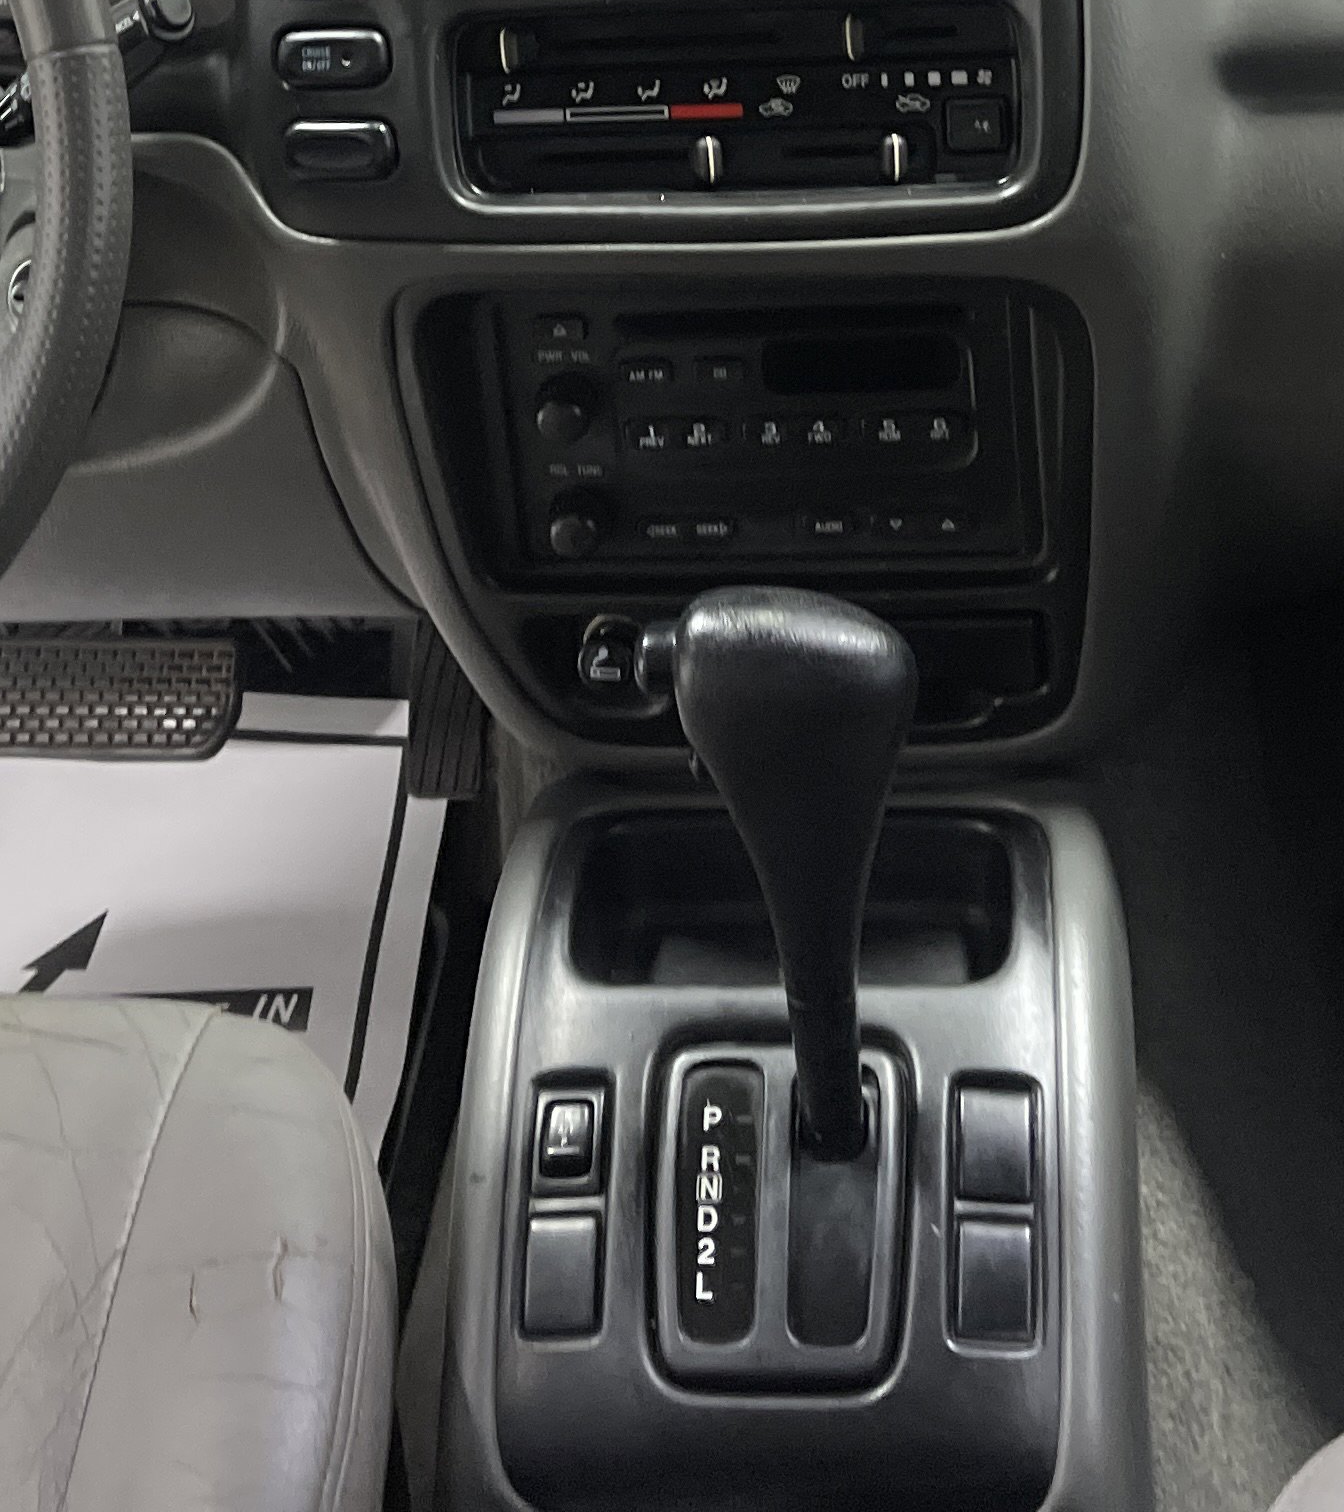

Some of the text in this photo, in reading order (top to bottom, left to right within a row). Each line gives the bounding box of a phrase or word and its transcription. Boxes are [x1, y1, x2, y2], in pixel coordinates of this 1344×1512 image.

[841, 72, 870, 89] OFF
[628, 368, 664, 382] AM FM
[253, 992, 299, 1025] IN
[703, 1104, 723, 1132] P
[702, 1145, 721, 1172] R
[700, 1175, 720, 1201] N
[697, 1205, 718, 1232] D
[697, 1238, 716, 1265] 2
[696, 1272, 713, 1300] L
